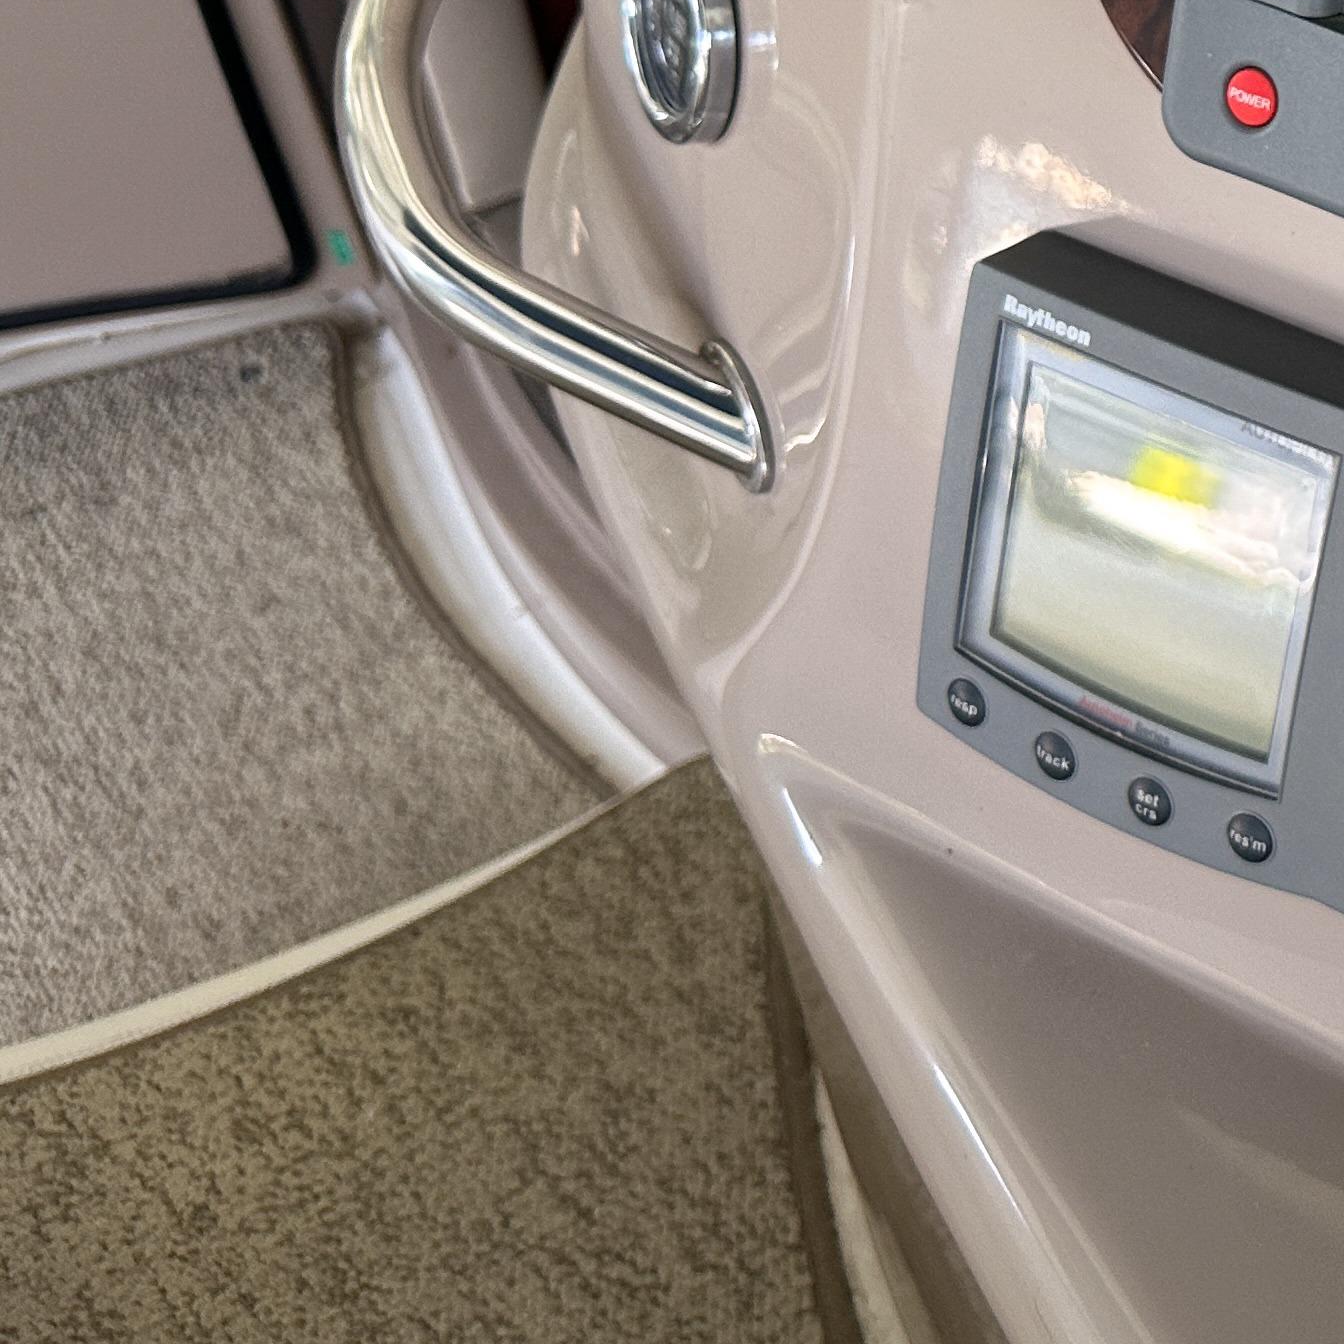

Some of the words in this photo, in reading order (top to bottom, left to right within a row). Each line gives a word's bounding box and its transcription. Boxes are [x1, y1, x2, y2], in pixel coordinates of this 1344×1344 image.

[1229, 86, 1272, 111] POWER
[1003, 293, 1091, 347] Raytheon
[950, 692, 978, 717] resp
[1036, 744, 1071, 772] track
[1136, 788, 1159, 807] set
[1135, 803, 1157, 820] crs
